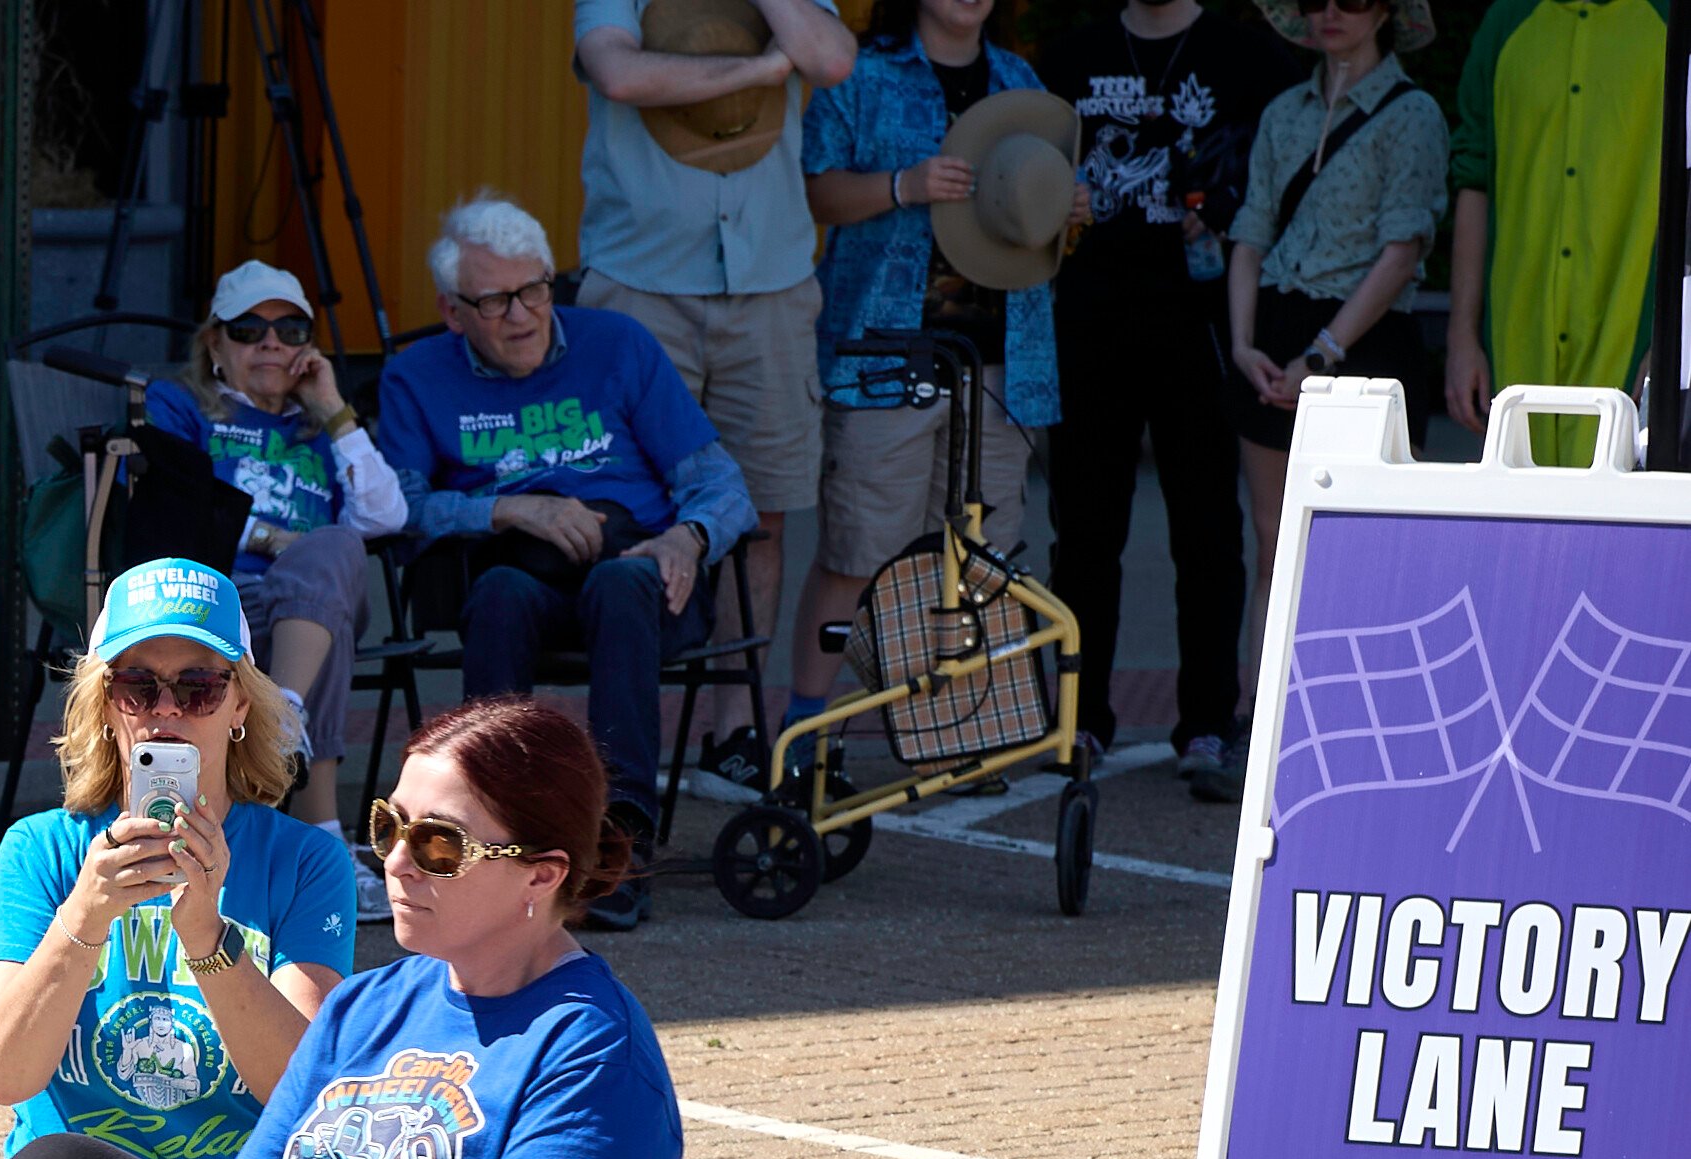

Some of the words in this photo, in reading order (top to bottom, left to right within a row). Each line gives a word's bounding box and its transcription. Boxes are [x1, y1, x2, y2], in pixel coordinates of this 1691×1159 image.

[1089, 75, 1147, 98] TEEN
[520, 397, 584, 437] BIG
[128, 567, 219, 590] CLEVELAND
[160, 582, 220, 606] WHEEL
[1292, 889, 1691, 1023] VICTORY
[392, 1054, 473, 1087] Can-Do
[324, 1078, 427, 1112] WHEEL
[424, 1080, 478, 1135] CREW
[1345, 1029, 1594, 1158] LANE
